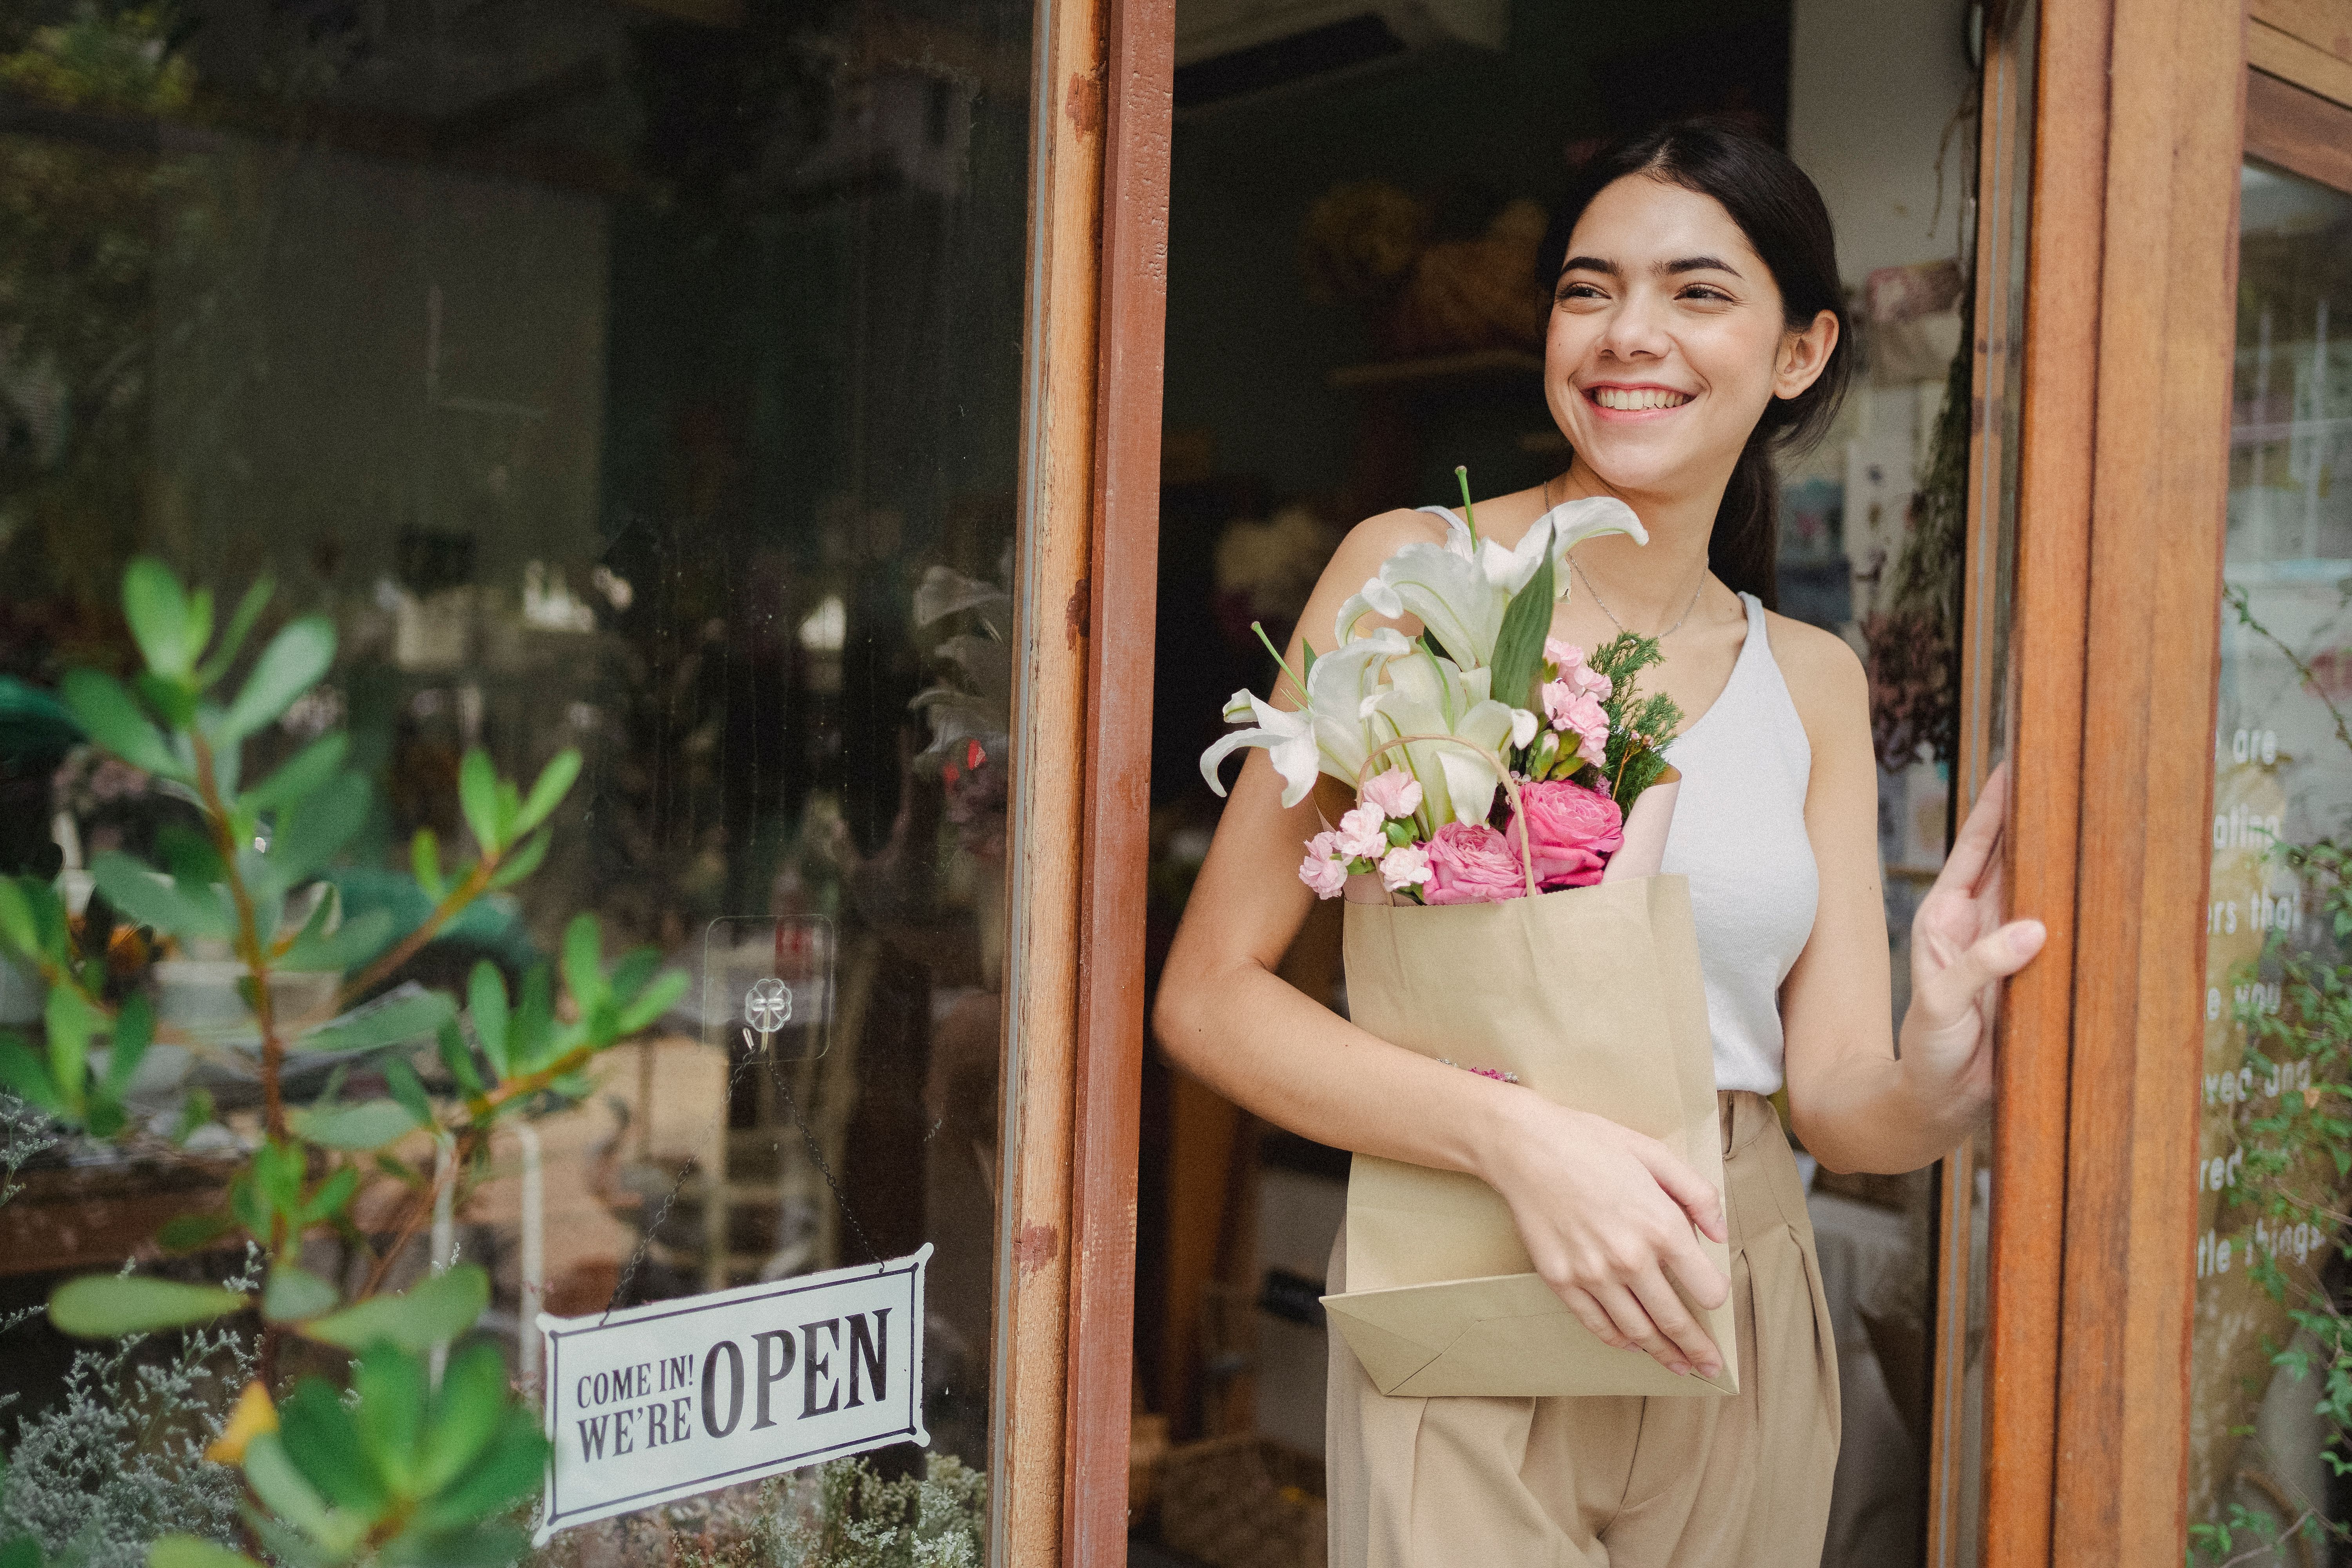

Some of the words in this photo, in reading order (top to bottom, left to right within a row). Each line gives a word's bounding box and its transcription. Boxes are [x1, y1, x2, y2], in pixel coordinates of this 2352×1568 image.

[577, 1363, 651, 1408] COME
[660, 1354, 694, 1392] IN!
[577, 1397, 691, 1463] WE'RE
[701, 1307, 893, 1438] OPEN
